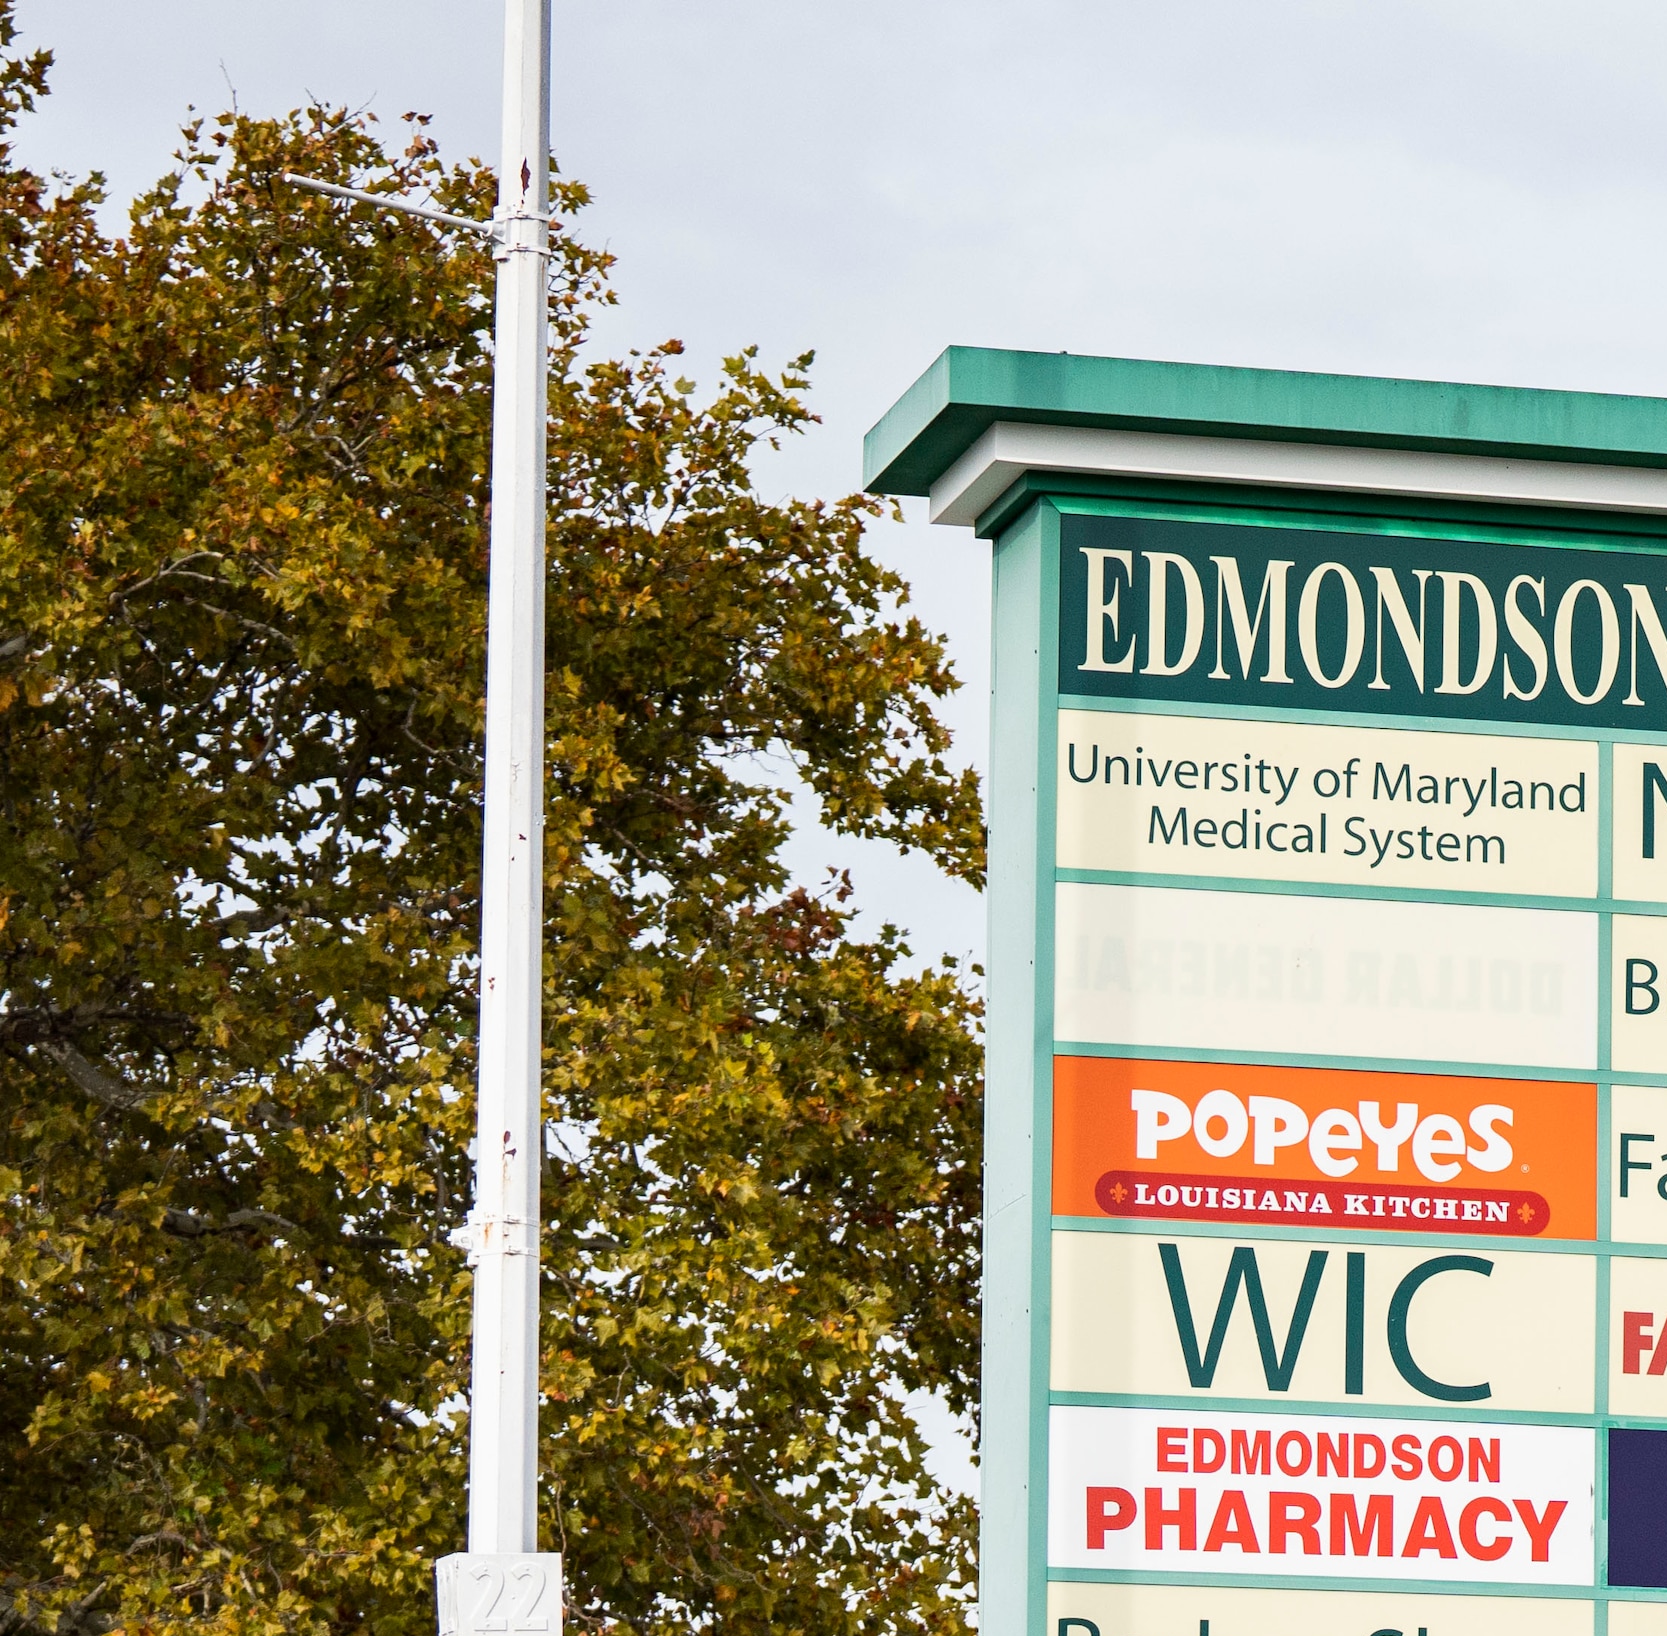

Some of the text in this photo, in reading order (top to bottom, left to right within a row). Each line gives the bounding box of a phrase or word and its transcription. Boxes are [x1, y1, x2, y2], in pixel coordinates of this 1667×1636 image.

[1069, 743, 1585, 816] University of Maryland
[1149, 806, 1504, 868] Medical System
[1135, 1184, 1511, 1223] LOUISIANA KITCHEN
[1157, 1243, 1495, 1402] WIC
[1157, 1427, 1500, 1483] EDMONDSON
[1086, 1487, 1568, 1562] PHARMACY
[469, 1560, 549, 1632] 22
